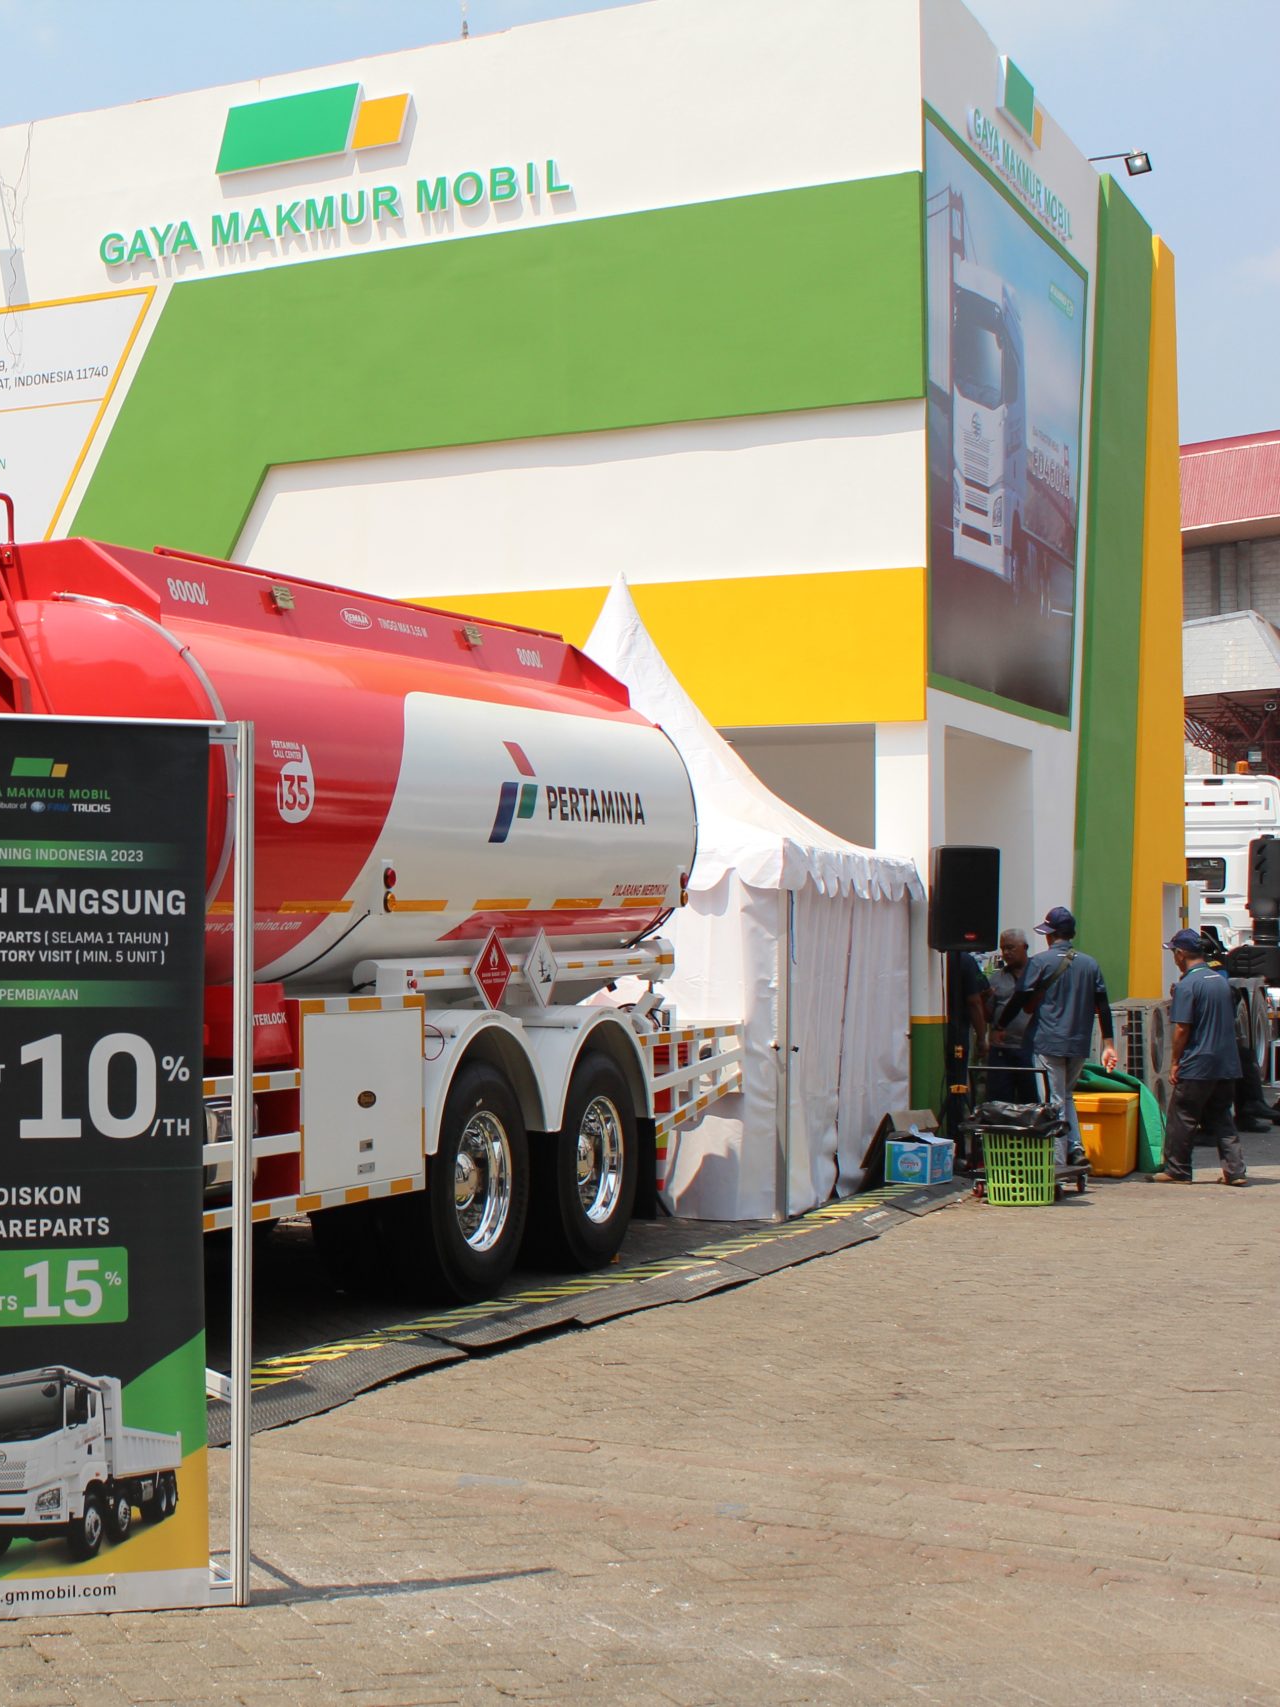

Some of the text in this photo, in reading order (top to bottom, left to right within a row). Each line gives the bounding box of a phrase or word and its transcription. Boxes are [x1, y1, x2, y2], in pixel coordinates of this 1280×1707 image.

[99, 158, 571, 266] GAYA MAKMUR MOBIL
[15, 370, 74, 388] INDONESIA
[76, 365, 109, 381] 11740
[270, 739, 300, 750] PERTAMINA
[6, 787, 65, 799] MAKMUR
[69, 788, 111, 800] MOBIL
[279, 774, 310, 811] 135
[19, 801, 27, 809] of
[72, 803, 111, 813] TRUCKS
[546, 785, 646, 826] PERTAMINA
[35, 848, 108, 862] INDONESIA
[111, 849, 144, 863] 2023
[18, 888, 187, 916] LANGSUNG
[52, 931, 103, 944] SELAMA
[118, 932, 161, 944] TAHUN
[38, 950, 72, 963] VISIT
[83, 951, 112, 963] MIN.
[116, 951, 123, 963] 5
[127, 951, 158, 963] UNIT
[0, 989, 78, 1001] PEMBIAYAAN
